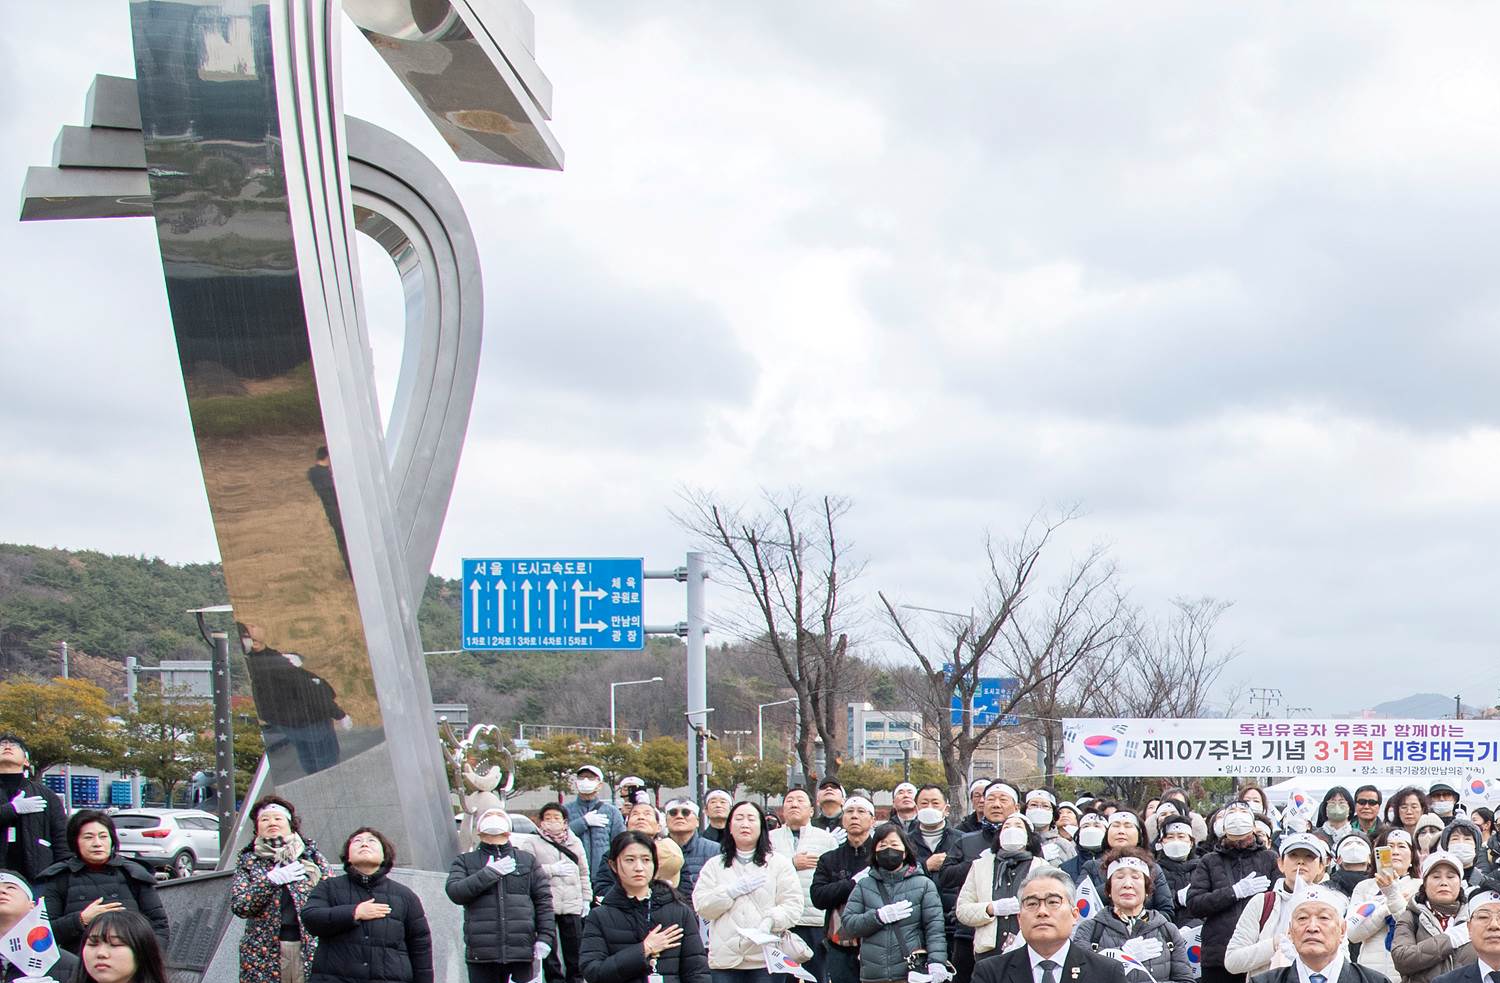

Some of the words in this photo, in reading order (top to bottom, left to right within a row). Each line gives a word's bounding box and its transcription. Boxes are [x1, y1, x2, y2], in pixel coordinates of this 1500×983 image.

[474, 562, 504, 576] 서울
[517, 562, 587, 576] 도시고속도로
[611, 591, 640, 604] 공원로
[611, 616, 641, 628] 만남의
[466, 636, 487, 647] 1차로
[491, 636, 512, 647] 2차로
[517, 636, 538, 647] 3차로
[542, 636, 563, 647] 4차로
[568, 636, 588, 647] 5차로
[1239, 723, 1327, 737] 독립유공자
[1334, 724, 1387, 737] 유족과
[1394, 724, 1464, 738] 함께하는
[1142, 740, 1252, 761] 제107주년
[1262, 740, 1305, 761] 기념
[1314, 740, 1374, 761] 3·1절
[1382, 741, 1498, 762] 대형태극기
[1310, 766, 1336, 774] 08:30
[1361, 766, 1379, 775] 장소
